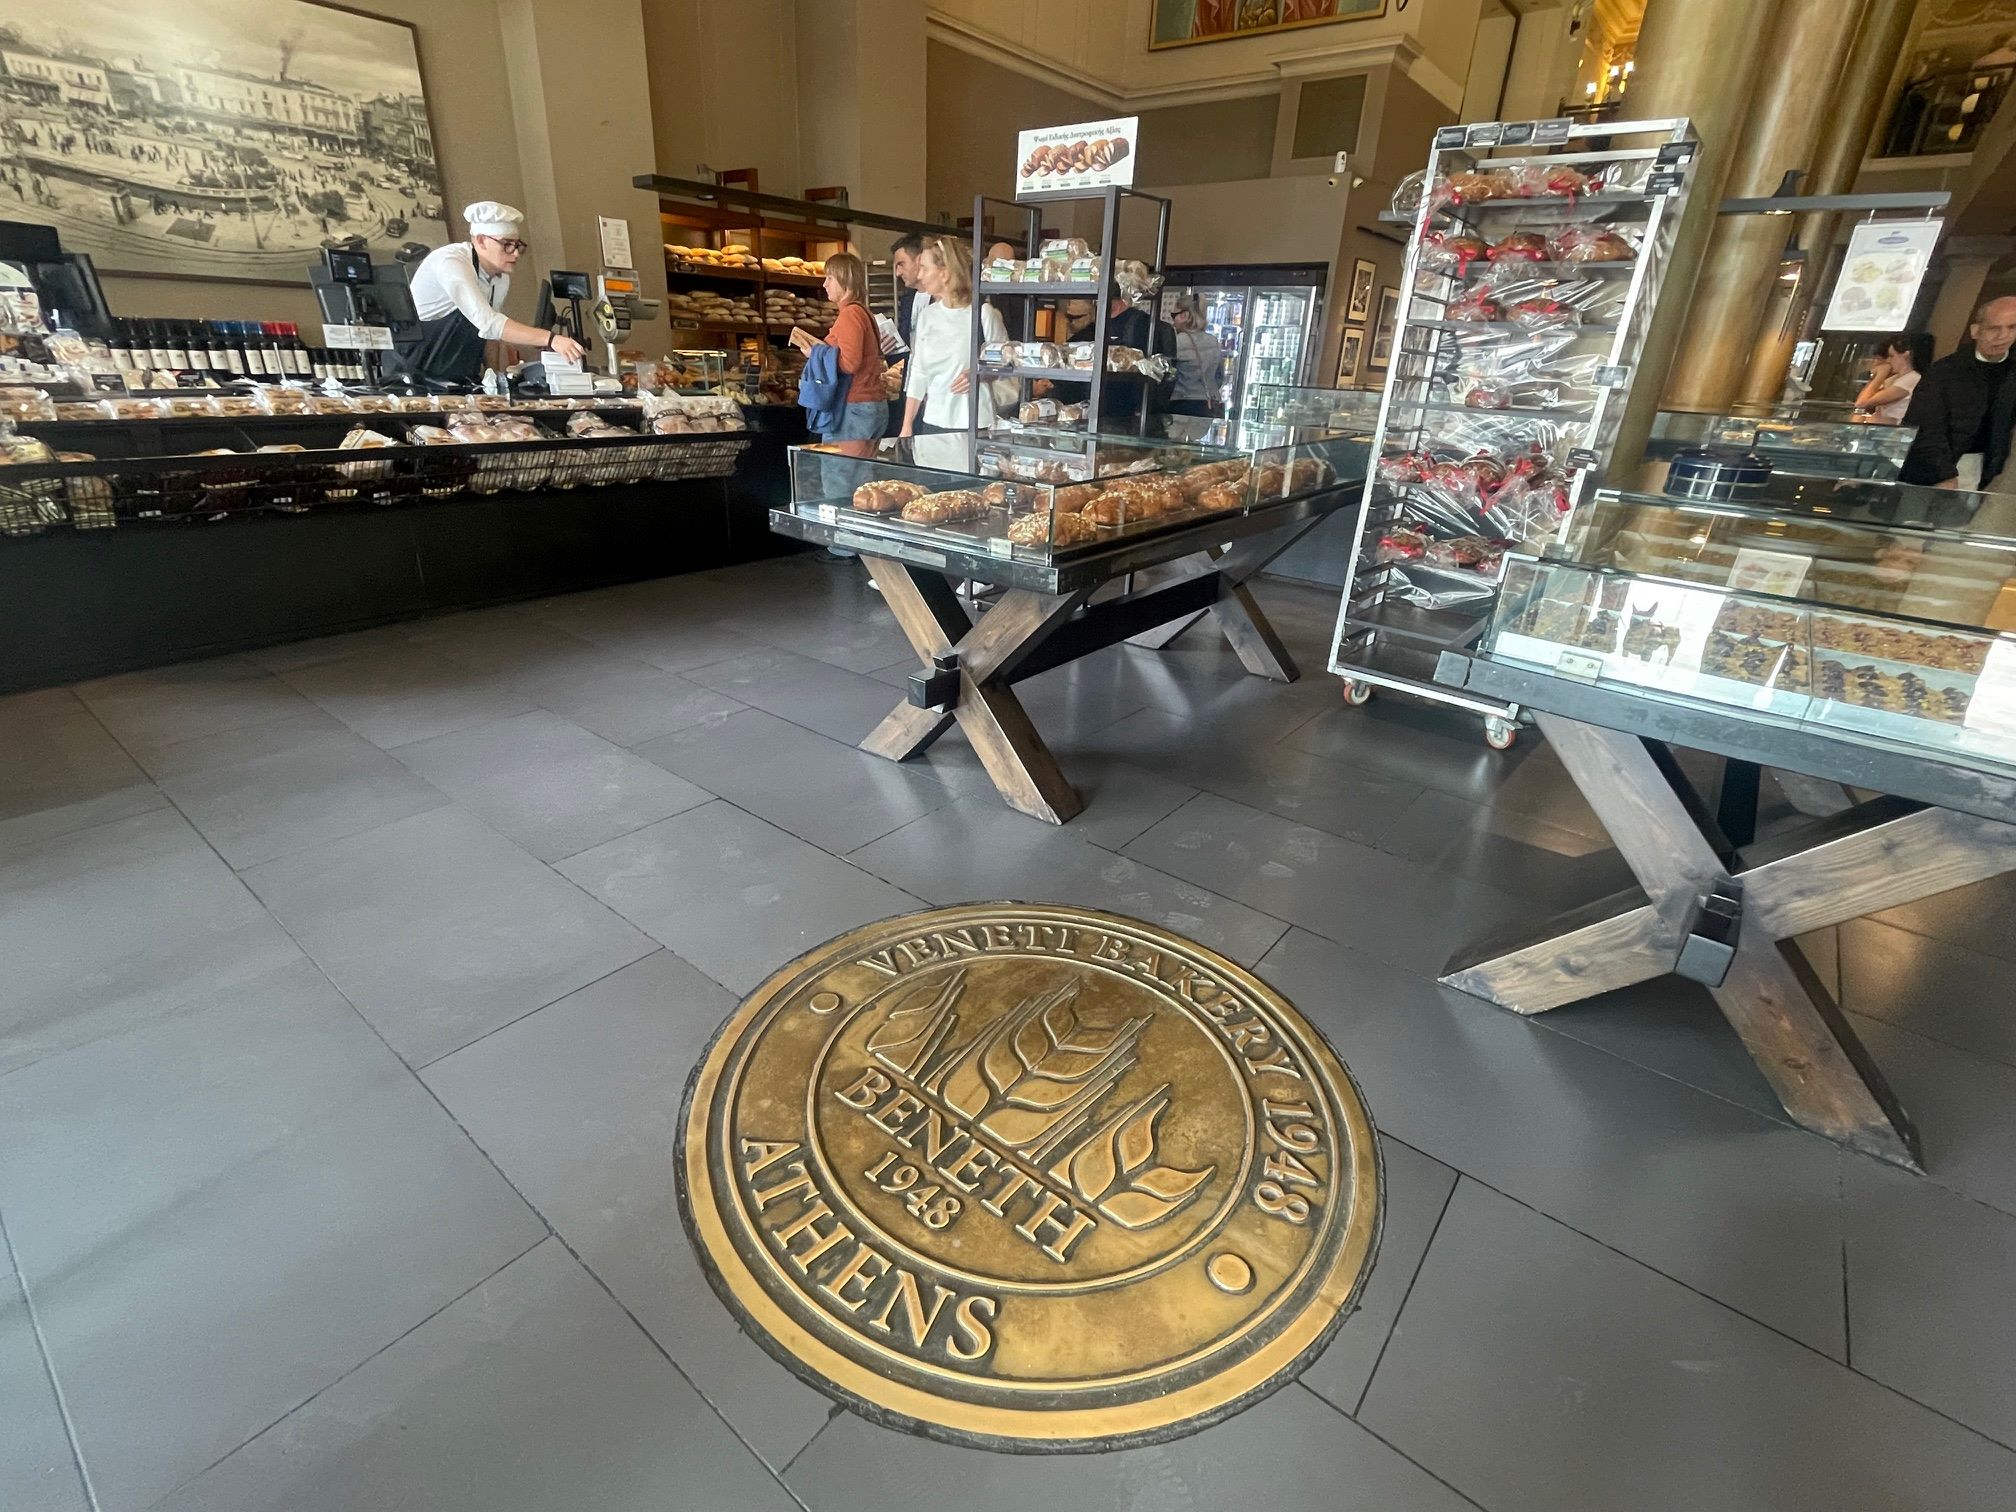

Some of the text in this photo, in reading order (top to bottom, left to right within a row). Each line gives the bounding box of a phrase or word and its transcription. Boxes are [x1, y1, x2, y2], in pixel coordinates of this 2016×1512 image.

[857, 924, 1325, 1225] VENETI BAKERY 1948
[741, 1136, 998, 1361] ATHENS
[863, 1151, 965, 1230] 1948
